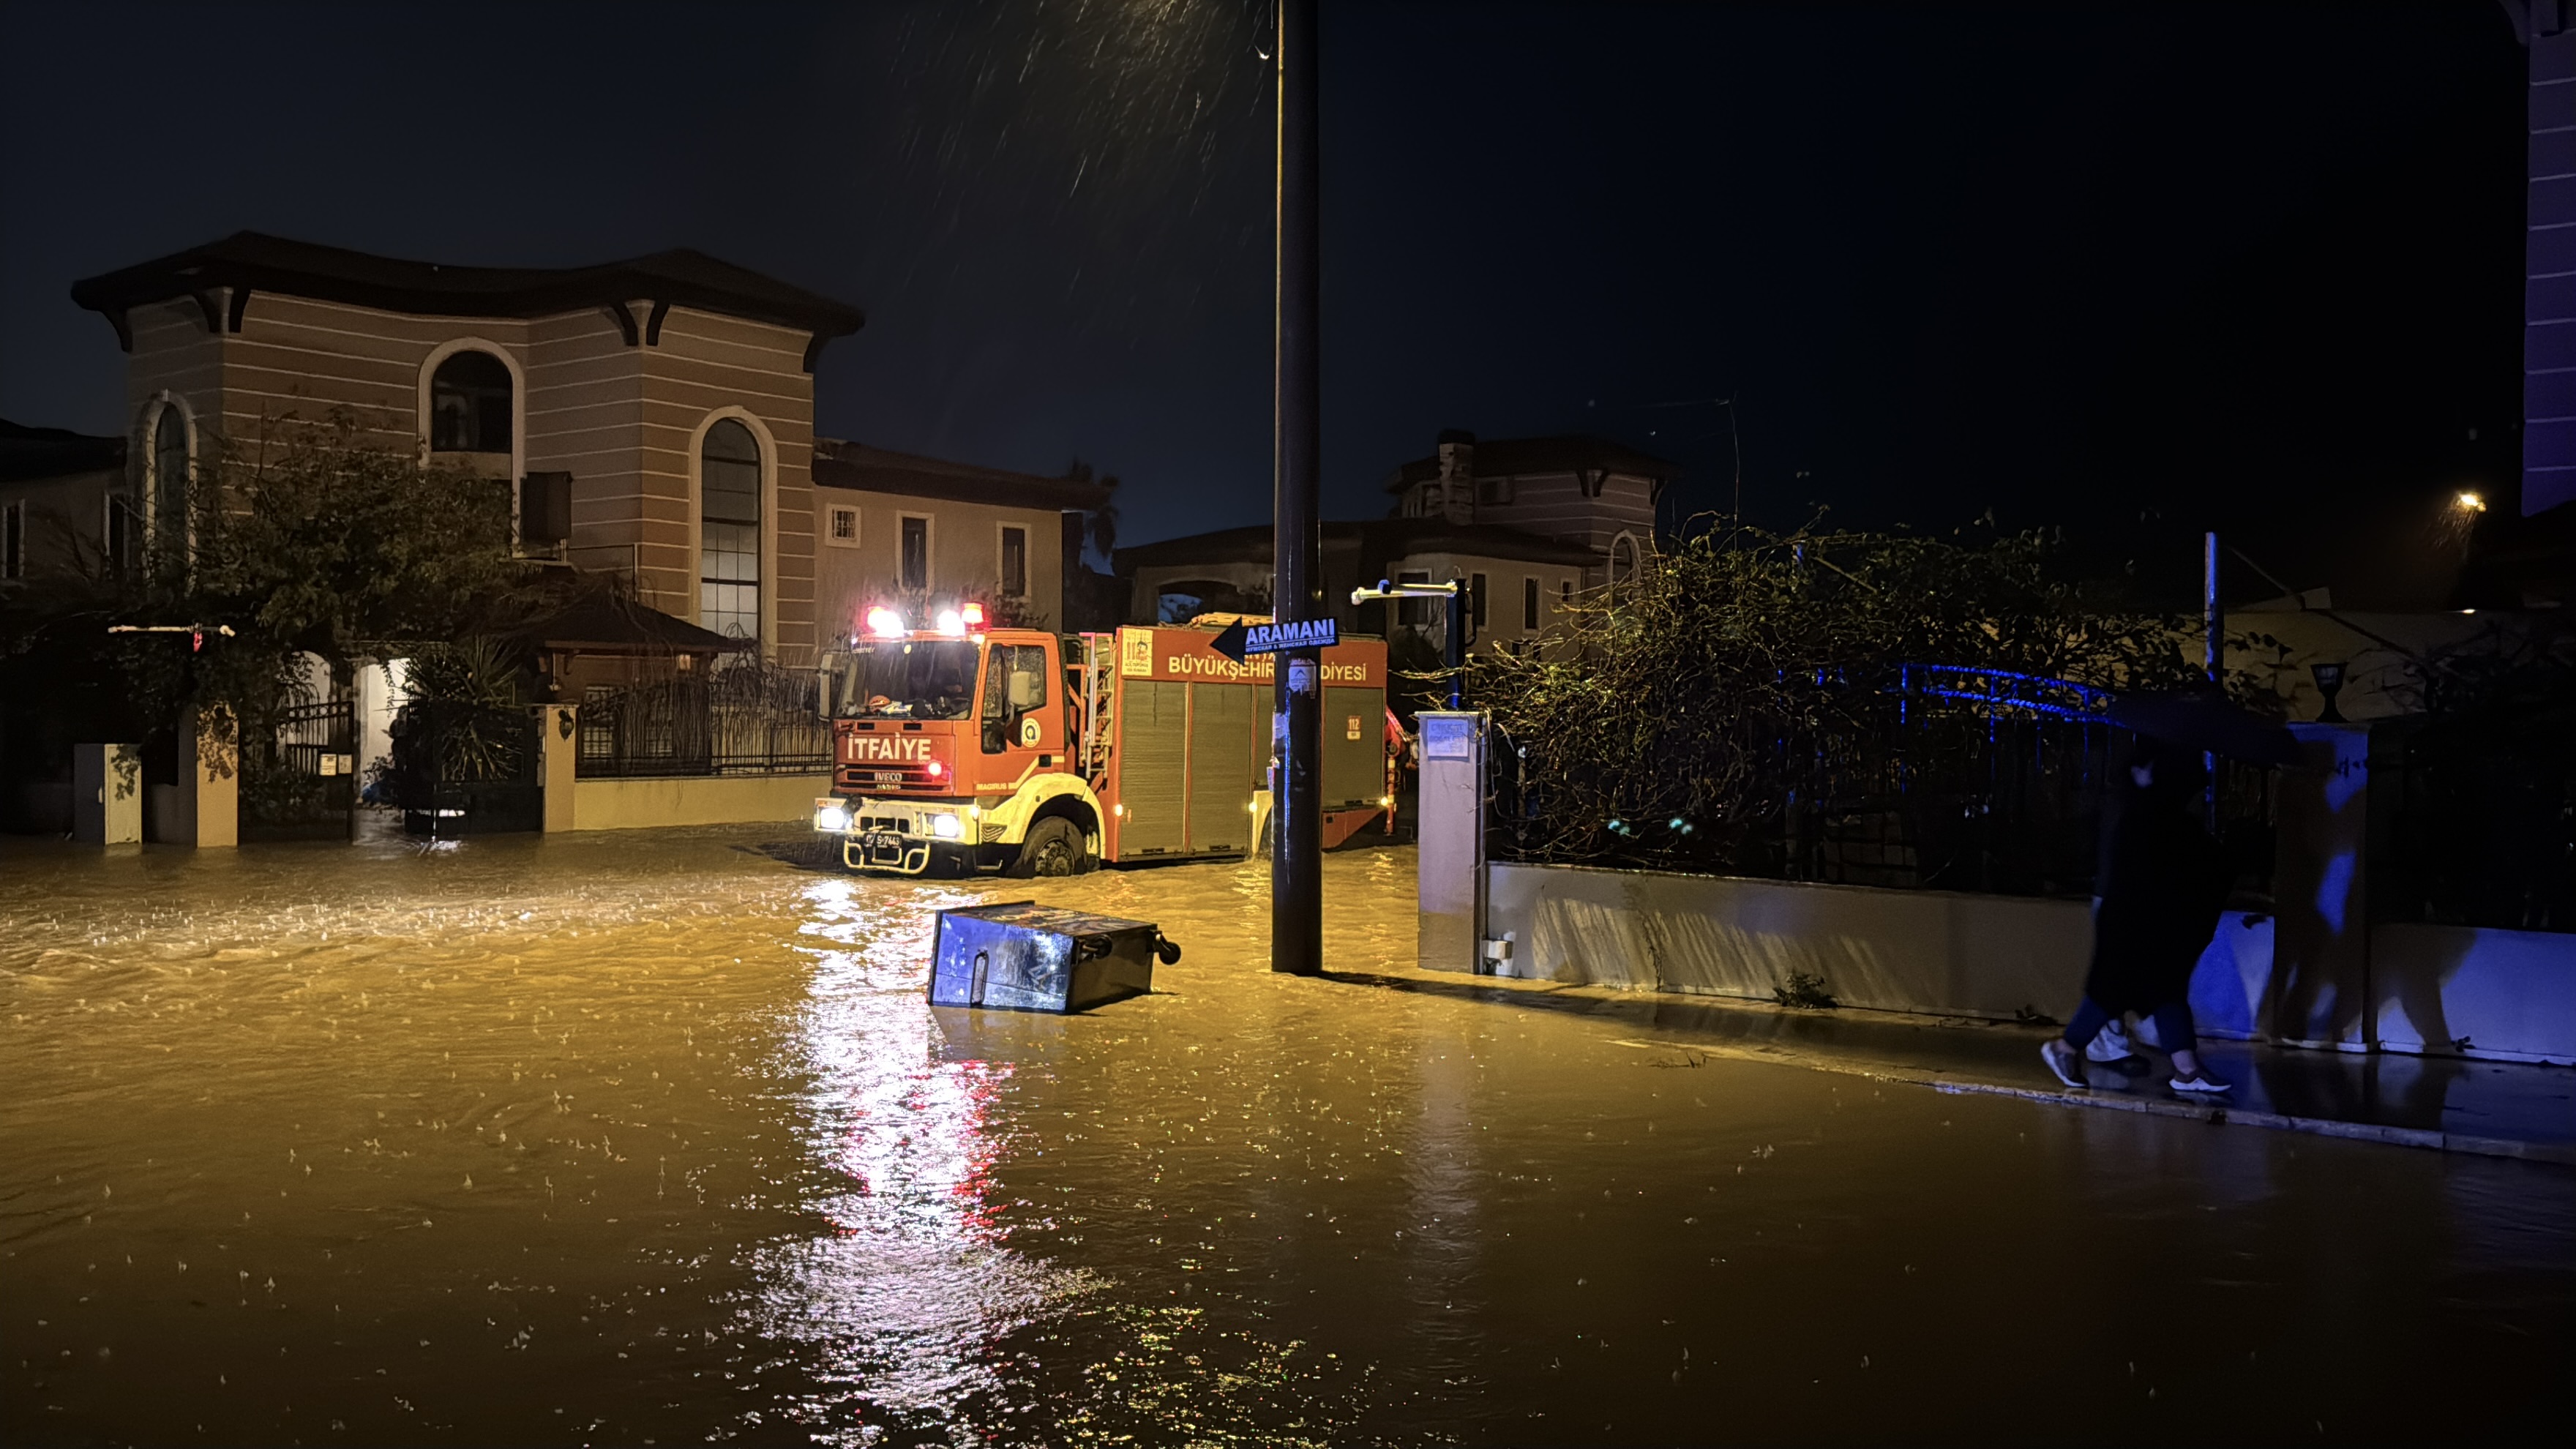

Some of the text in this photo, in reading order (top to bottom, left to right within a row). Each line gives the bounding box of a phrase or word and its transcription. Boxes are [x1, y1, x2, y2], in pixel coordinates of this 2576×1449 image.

[1246, 618, 1335, 645] ARAMANI
[1308, 638, 1335, 646] ОДЕЖДА
[1169, 654, 1275, 681] BÜYÜKŞEHİR
[1320, 661, 1366, 681] DİYESİ
[1349, 718, 1360, 730] 112
[847, 732, 932, 760] İTFAİYE
[875, 772, 902, 782] IVECO
[976, 782, 1007, 790] MAGIRUS
